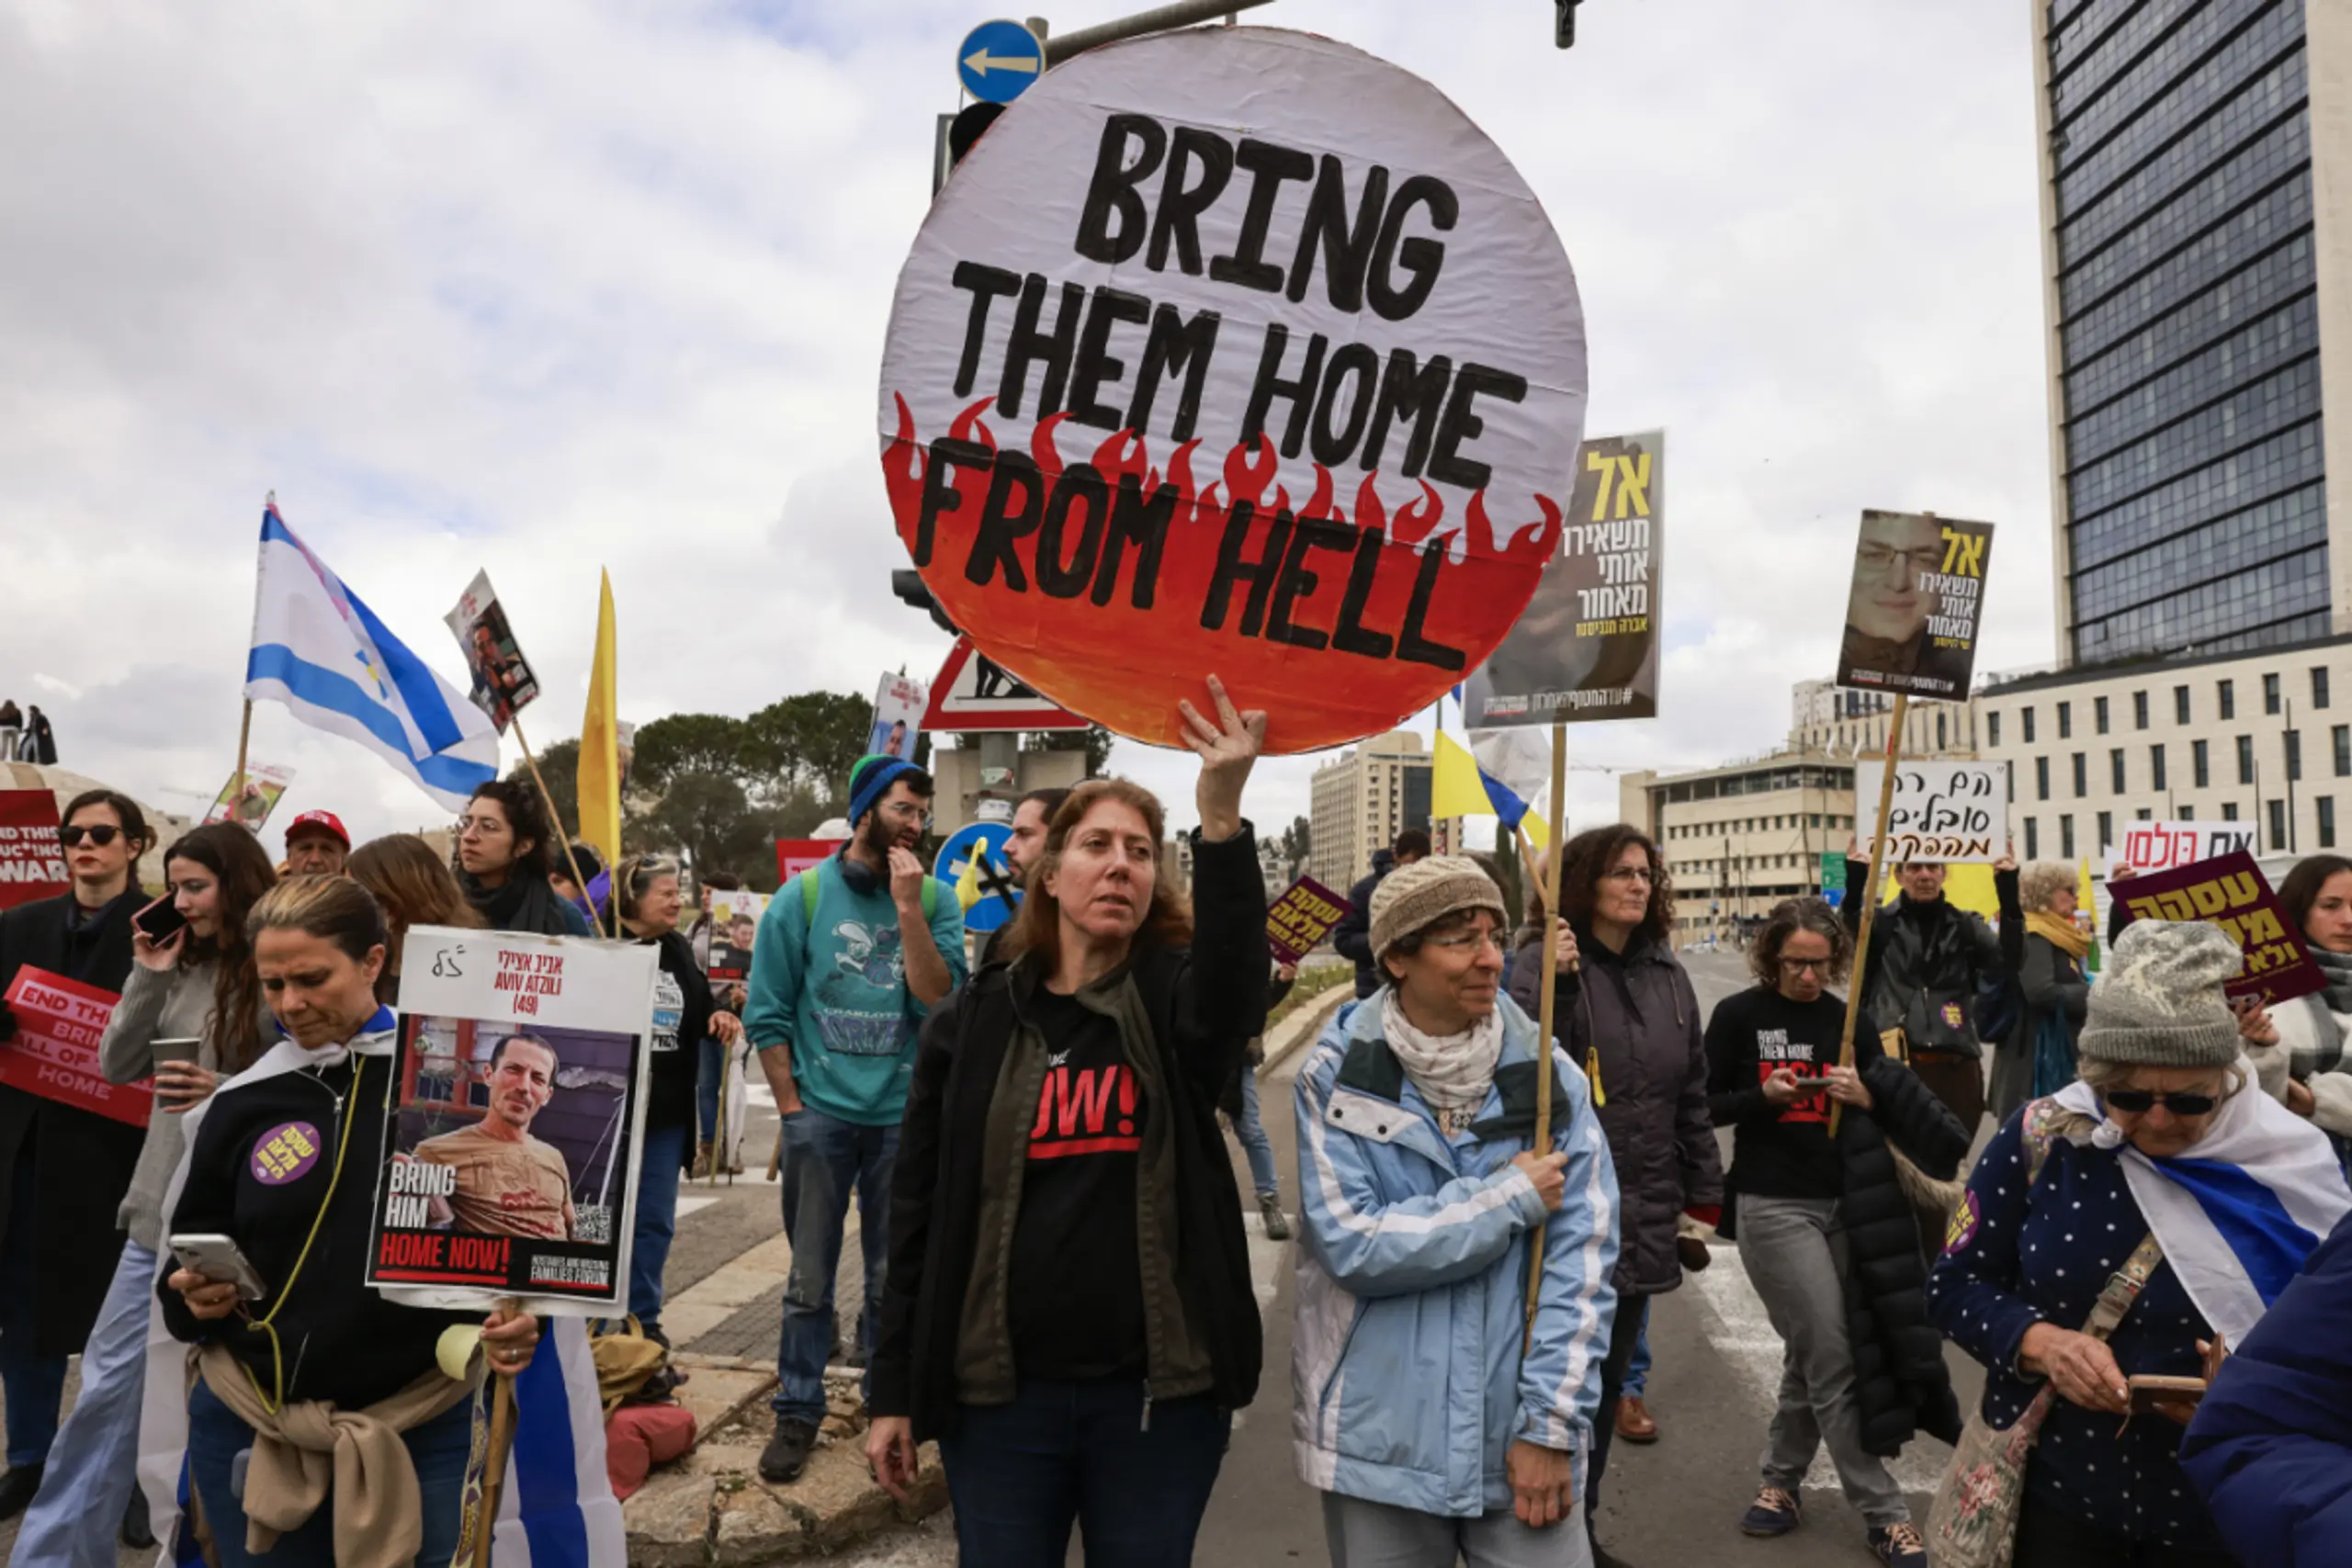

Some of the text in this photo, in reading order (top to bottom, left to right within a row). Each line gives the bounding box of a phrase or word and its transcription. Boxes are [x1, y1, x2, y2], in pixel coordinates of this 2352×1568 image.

[1075, 114, 1459, 321] BRING
[952, 261, 1528, 490] THEM HOME
[1588, 451, 1651, 521] אל
[914, 437, 1466, 671] FROM HELL
[1562, 519, 1649, 557] תשאירו
[1940, 526, 1984, 577] אל
[1599, 551, 1648, 583] אותי
[1919, 571, 1979, 597] תשאירו
[1577, 584, 1647, 619] מאחור
[1940, 595, 1976, 618] אותי
[1925, 615, 1973, 639] מאחור
[19, 826, 60, 840] THIS
[1270, 901, 1327, 942] מלאה
[1287, 886, 1343, 924] עסקה
[498, 950, 564, 975] אביב אצילי
[21, 987, 69, 1010] END
[493, 971, 561, 996] AVIV ATZILI
[513, 993, 538, 1016] (49)
[59, 1048, 89, 1066] OF
[38, 1066, 112, 1100] HOME
[389, 1162, 457, 1195] BRING
[384, 1196, 429, 1228] HIM
[379, 1233, 511, 1273] HOME NOW!
